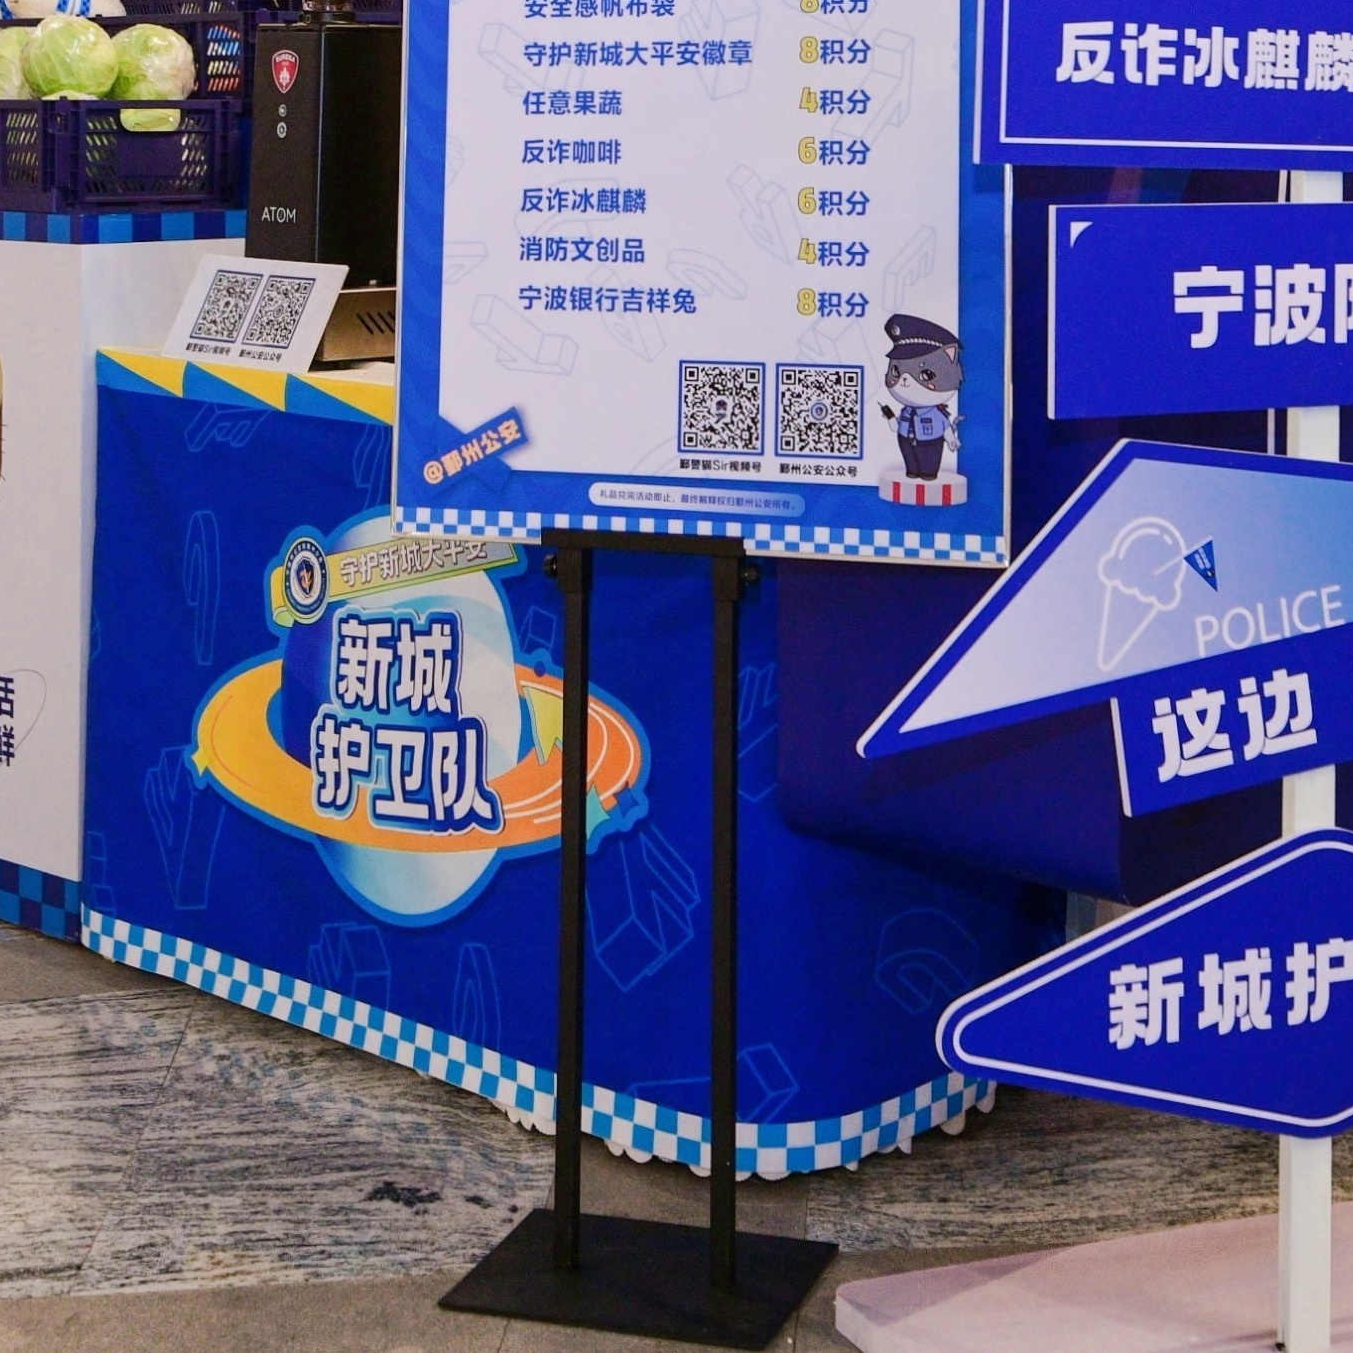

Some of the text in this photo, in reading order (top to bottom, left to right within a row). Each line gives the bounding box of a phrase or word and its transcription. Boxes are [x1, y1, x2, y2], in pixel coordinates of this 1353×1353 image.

[523, 36, 873, 68] 守护新城大平安徽章 8积分
[522, 86, 872, 117] 任意果蔬 4积分
[521, 136, 872, 166] 反诈咖啡 6积分
[261, 206, 297, 224] ATOM
[520, 187, 871, 217] 反诈冰麒麟 6积分
[519, 236, 871, 267] 消防文创品 4积分
[518, 285, 870, 319] 宁波银行吉祥兔 8积分
[423, 418, 523, 485] @鄞州公安
[679, 458, 762, 474] 鄞警猫Sir视频号
[779, 462, 858, 478] 鄞州公安公众号
[339, 539, 488, 587] 守护新城大平安
[1194, 582, 1345, 658] POLICE
[338, 617, 454, 713] 新城
[1151, 669, 1319, 783] 这边
[316, 720, 499, 823] 护卫队
